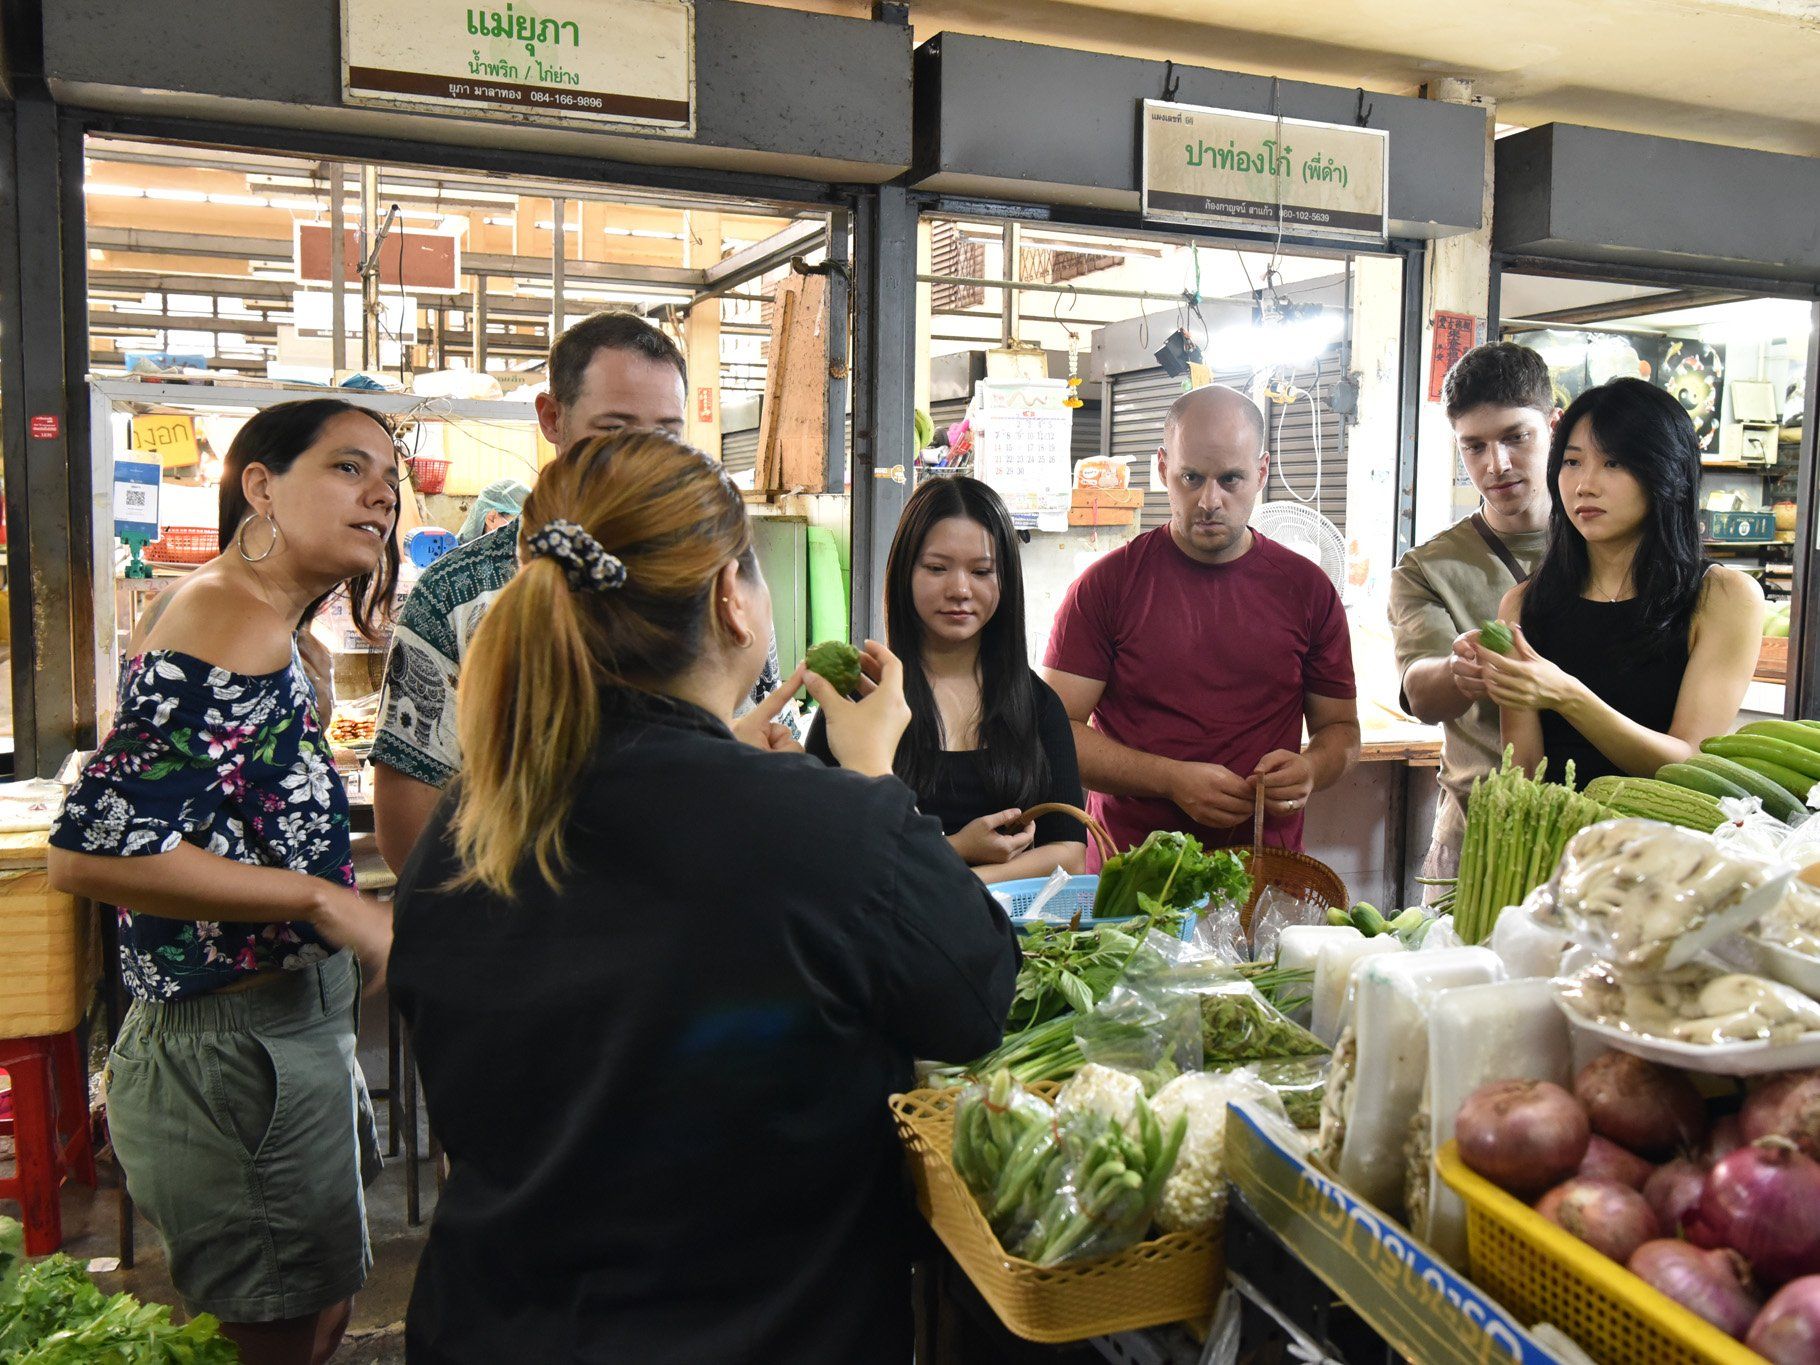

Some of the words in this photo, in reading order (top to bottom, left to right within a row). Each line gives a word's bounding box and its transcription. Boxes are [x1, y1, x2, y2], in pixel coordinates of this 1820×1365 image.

[467, 3, 579, 57] แม่ยุภา
[468, 49, 518, 79] น้ำพริก
[535, 60, 580, 86] ไก่ย่าง
[448, 83, 470, 98] ยุภา
[474, 86, 522, 100] มาลาทอง
[530, 91, 603, 108] 084-166-9896
[1185, 140, 1293, 177] ปาท่องโก๋
[1302, 152, 1348, 188] (พี่ดำ)
